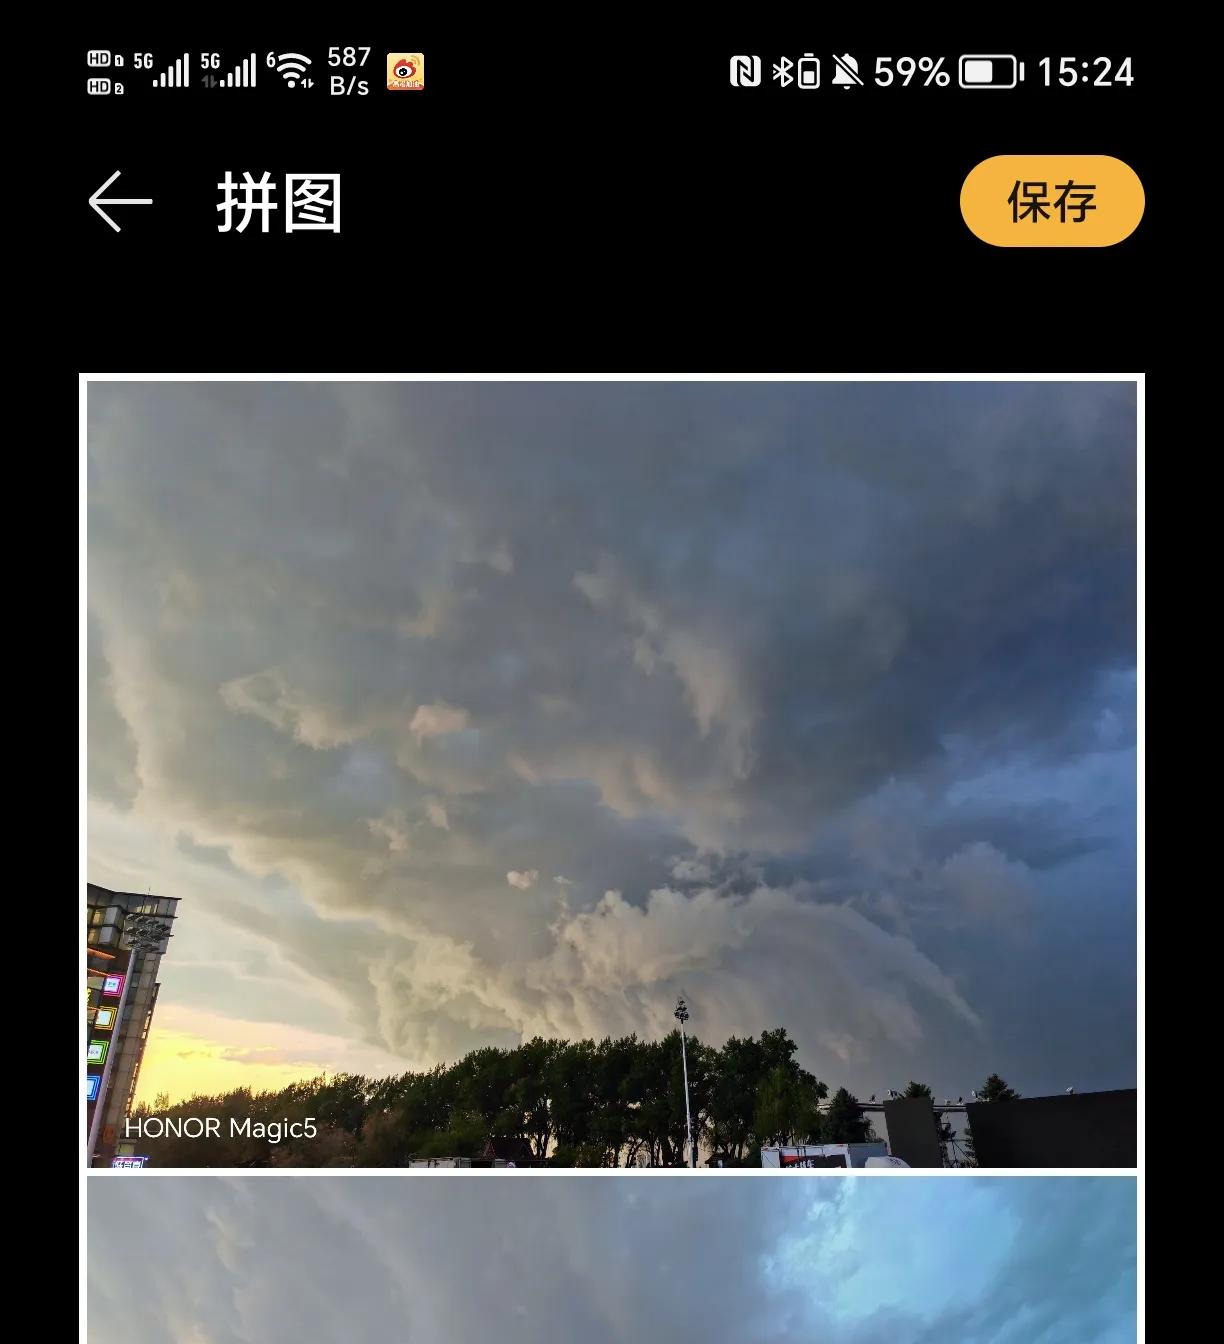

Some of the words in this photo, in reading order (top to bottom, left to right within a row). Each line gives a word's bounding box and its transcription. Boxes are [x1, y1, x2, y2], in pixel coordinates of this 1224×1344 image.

[88, 51, 110, 66] HD
[134, 53, 153, 69] 5G
[201, 53, 220, 69] 5G
[328, 47, 370, 66] 587
[875, 57, 950, 86] 59%
[1039, 57, 1134, 86] 15:24
[88, 79, 110, 94] HD
[331, 76, 368, 95] B/s
[216, 171, 341, 233] 拼图
[1008, 180, 1097, 223] 保存
